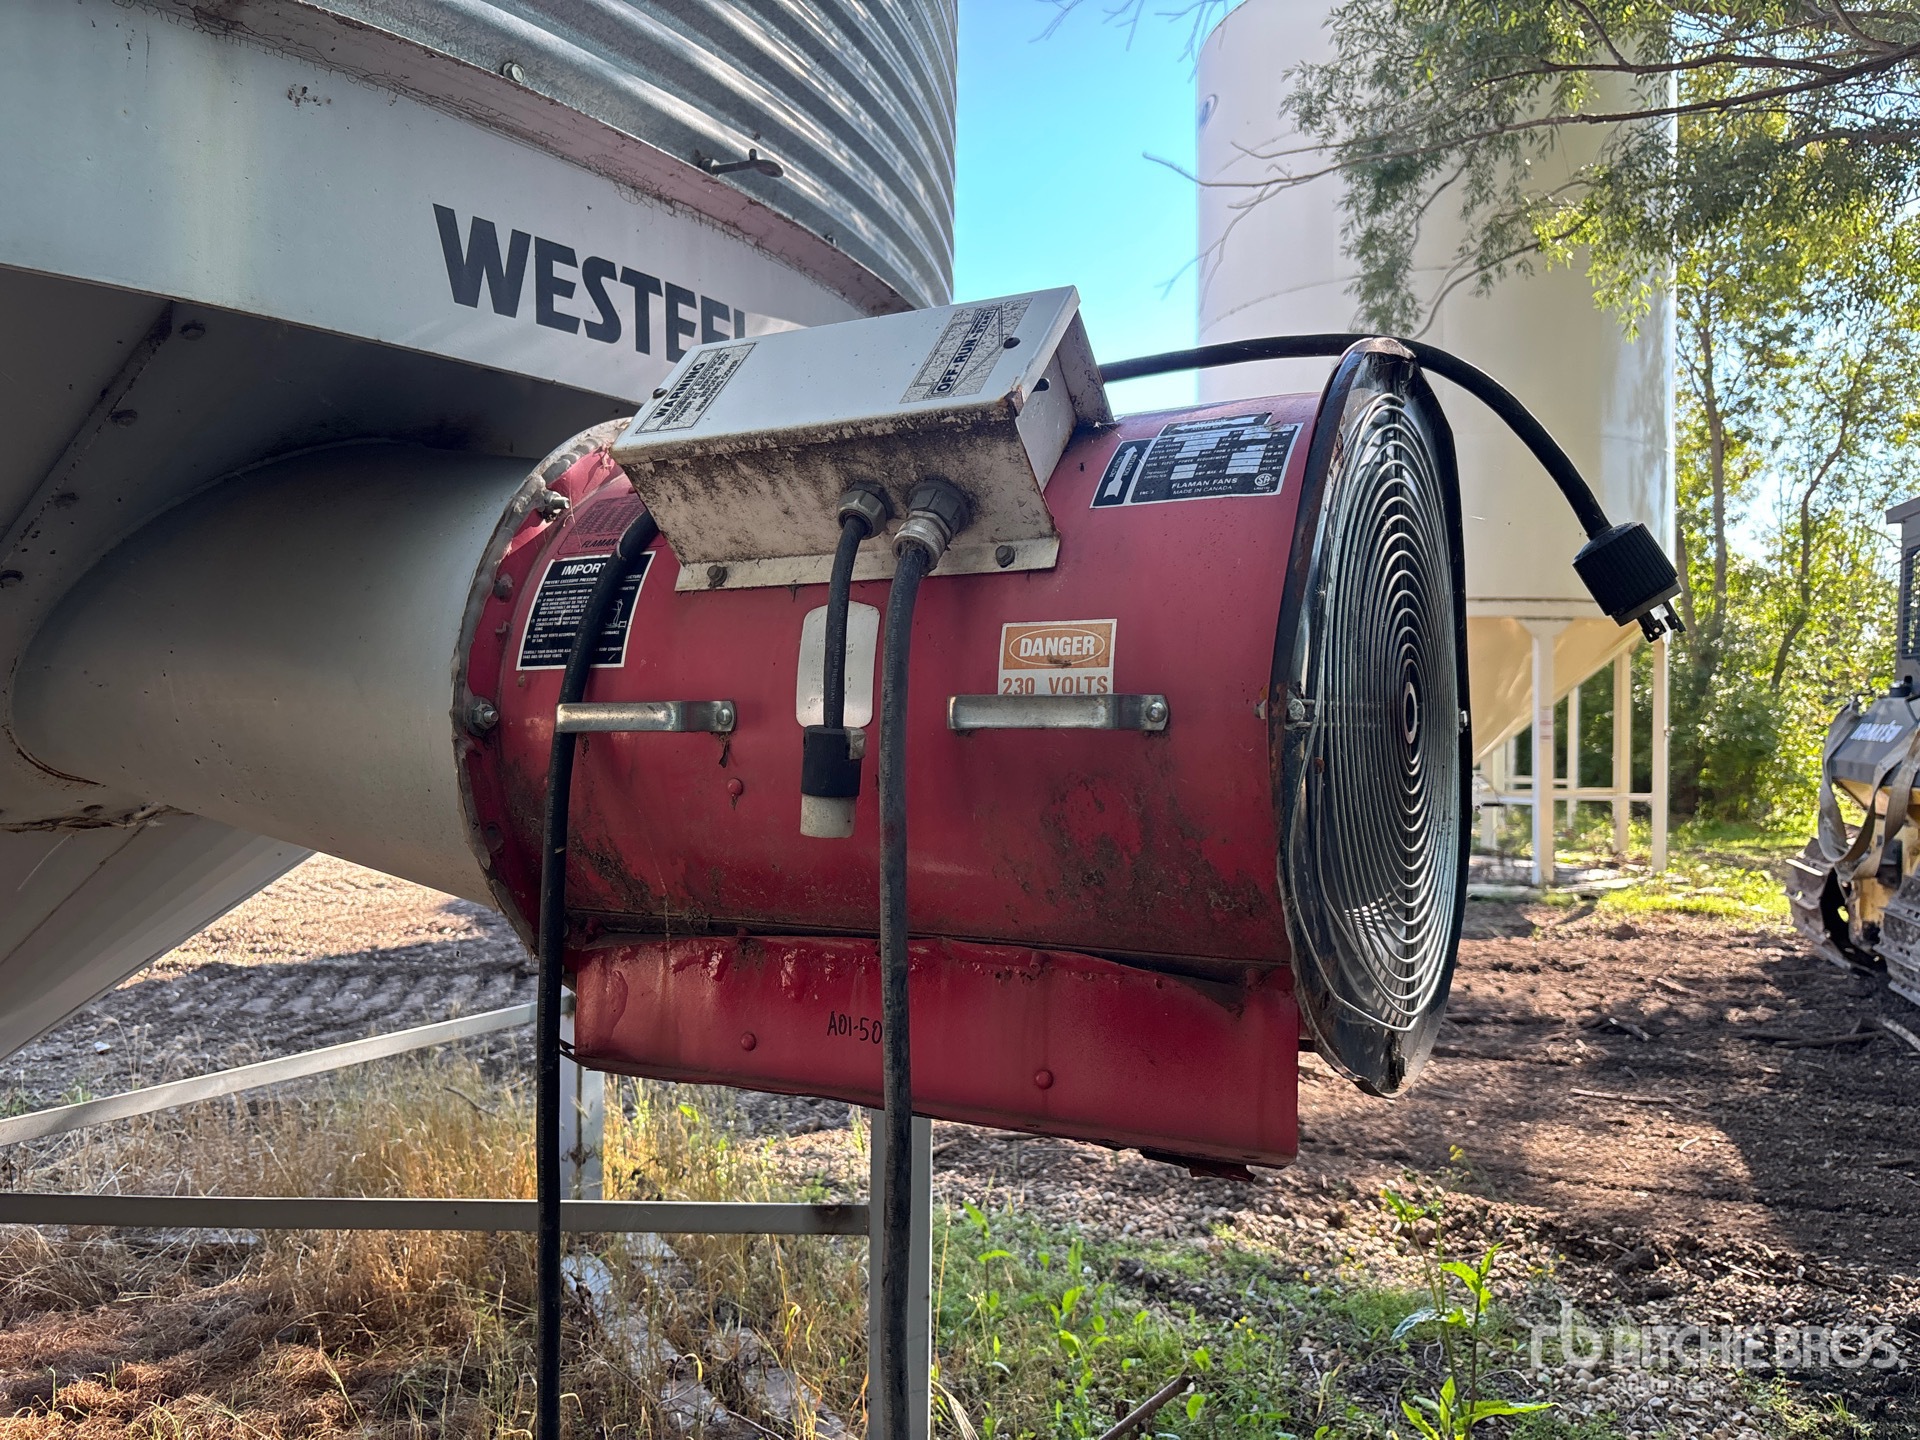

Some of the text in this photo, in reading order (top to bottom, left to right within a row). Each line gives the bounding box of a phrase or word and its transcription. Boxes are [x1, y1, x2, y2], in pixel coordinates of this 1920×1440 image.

[976, 311, 994, 334] START
[720, 359, 740, 380] COVER
[936, 339, 978, 392] OFF RUN
[653, 362, 706, 419] WARNING
[1171, 477, 1239, 489] FLAMAN FANS
[582, 538, 619, 548] FLAMAN
[1019, 635, 1096, 657] DANGER
[1002, 675, 1109, 695] 230 VOLTS
